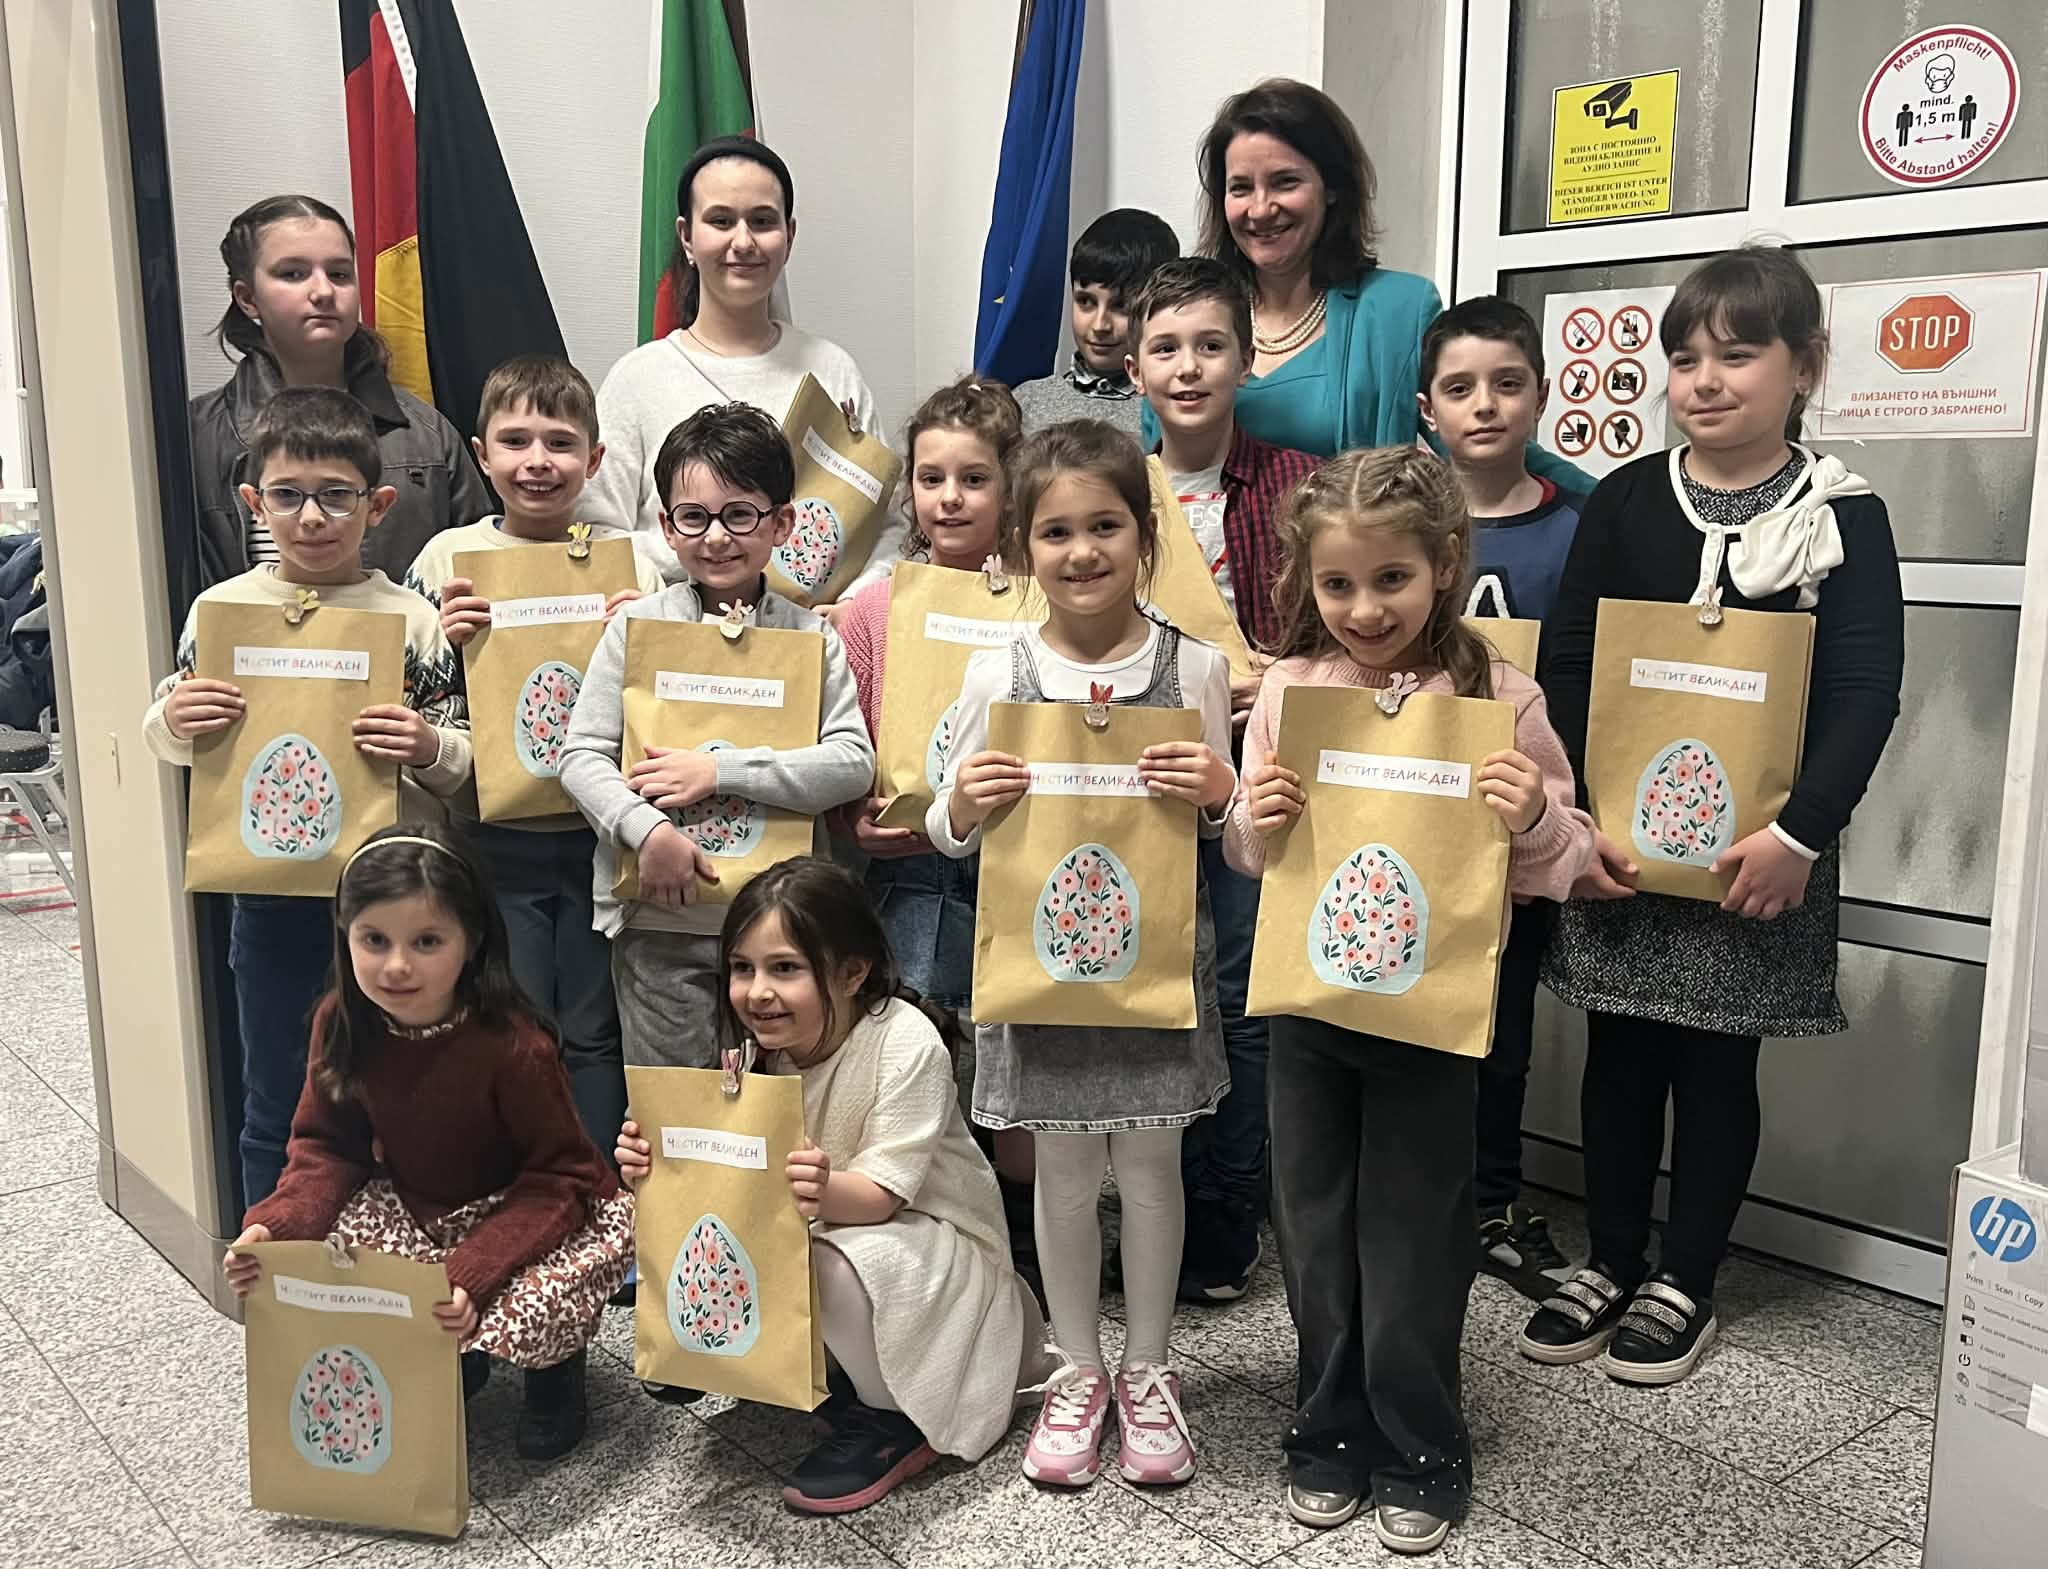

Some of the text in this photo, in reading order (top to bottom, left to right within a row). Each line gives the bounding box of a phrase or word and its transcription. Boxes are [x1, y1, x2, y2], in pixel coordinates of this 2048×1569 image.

[1893, 37, 1992, 72] Maskenpflicht!
[1920, 95, 1954, 109] mind.
[1915, 112, 1955, 127] 1,5 m
[1875, 122, 1999, 175] Bitte Abstand halten!
[1555, 177, 1667, 197] DIESER BEREICH IST UNTER
[1562, 188, 1659, 206] STÄNDIGER VIDEO- UND
[1563, 199, 1655, 216] AUDIOÜBERWACHUNG
[1889, 314, 1961, 351] STOP
[1851, 388, 1997, 402] ВЛИЗАНЕТО НА ВЪНШНИ
[1839, 403, 2007, 418] ЛИЦА Е СТРОГО ЗАБРАНЕНО!
[496, 607, 535, 620] ЧТИТ
[240, 656, 289, 669] ЧСТИТ
[1637, 668, 1688, 681] ЧСТИТ
[661, 680, 709, 692] ЧТИТ
[1326, 761, 1380, 777] ЧСТИТ
[1032, 773, 1146, 788] ЧСТИТ ВЕЛИКДЕ
[667, 1136, 709, 1150] ЧСТИТ
[1976, 1196, 2031, 1264] hp
[280, 1284, 327, 1301] ЧТИТ
[1965, 1272, 2044, 1309] Print Scan Copy
